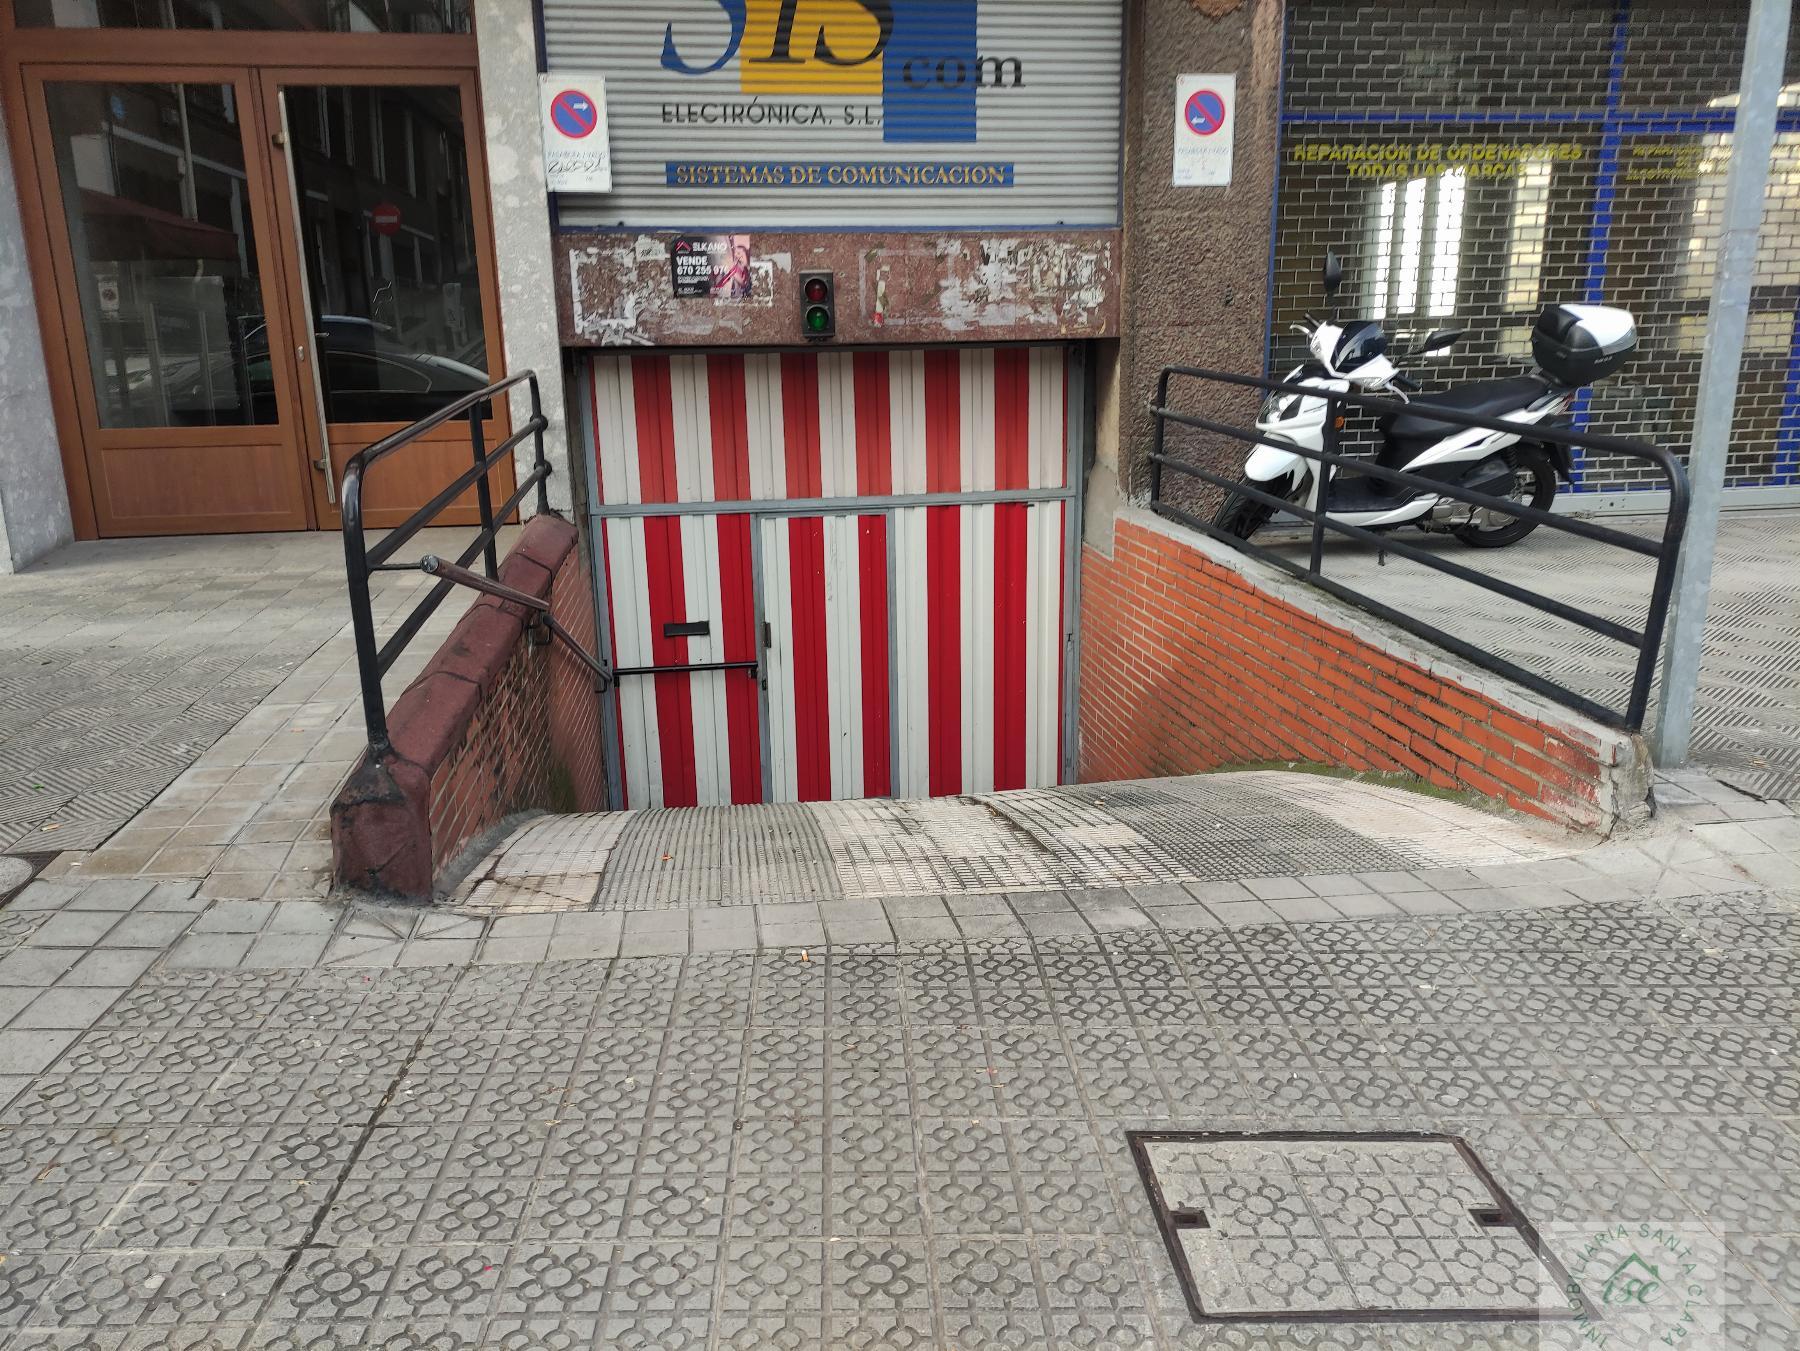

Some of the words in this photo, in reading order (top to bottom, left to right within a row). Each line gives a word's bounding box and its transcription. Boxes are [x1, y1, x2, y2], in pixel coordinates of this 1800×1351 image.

[903, 55, 1025, 89] com
[676, 165, 785, 185] SISTEMAS
[790, 165, 822, 185] DE
[827, 165, 1005, 185] COMUNICACION
[676, 255, 708, 266] VENDE
